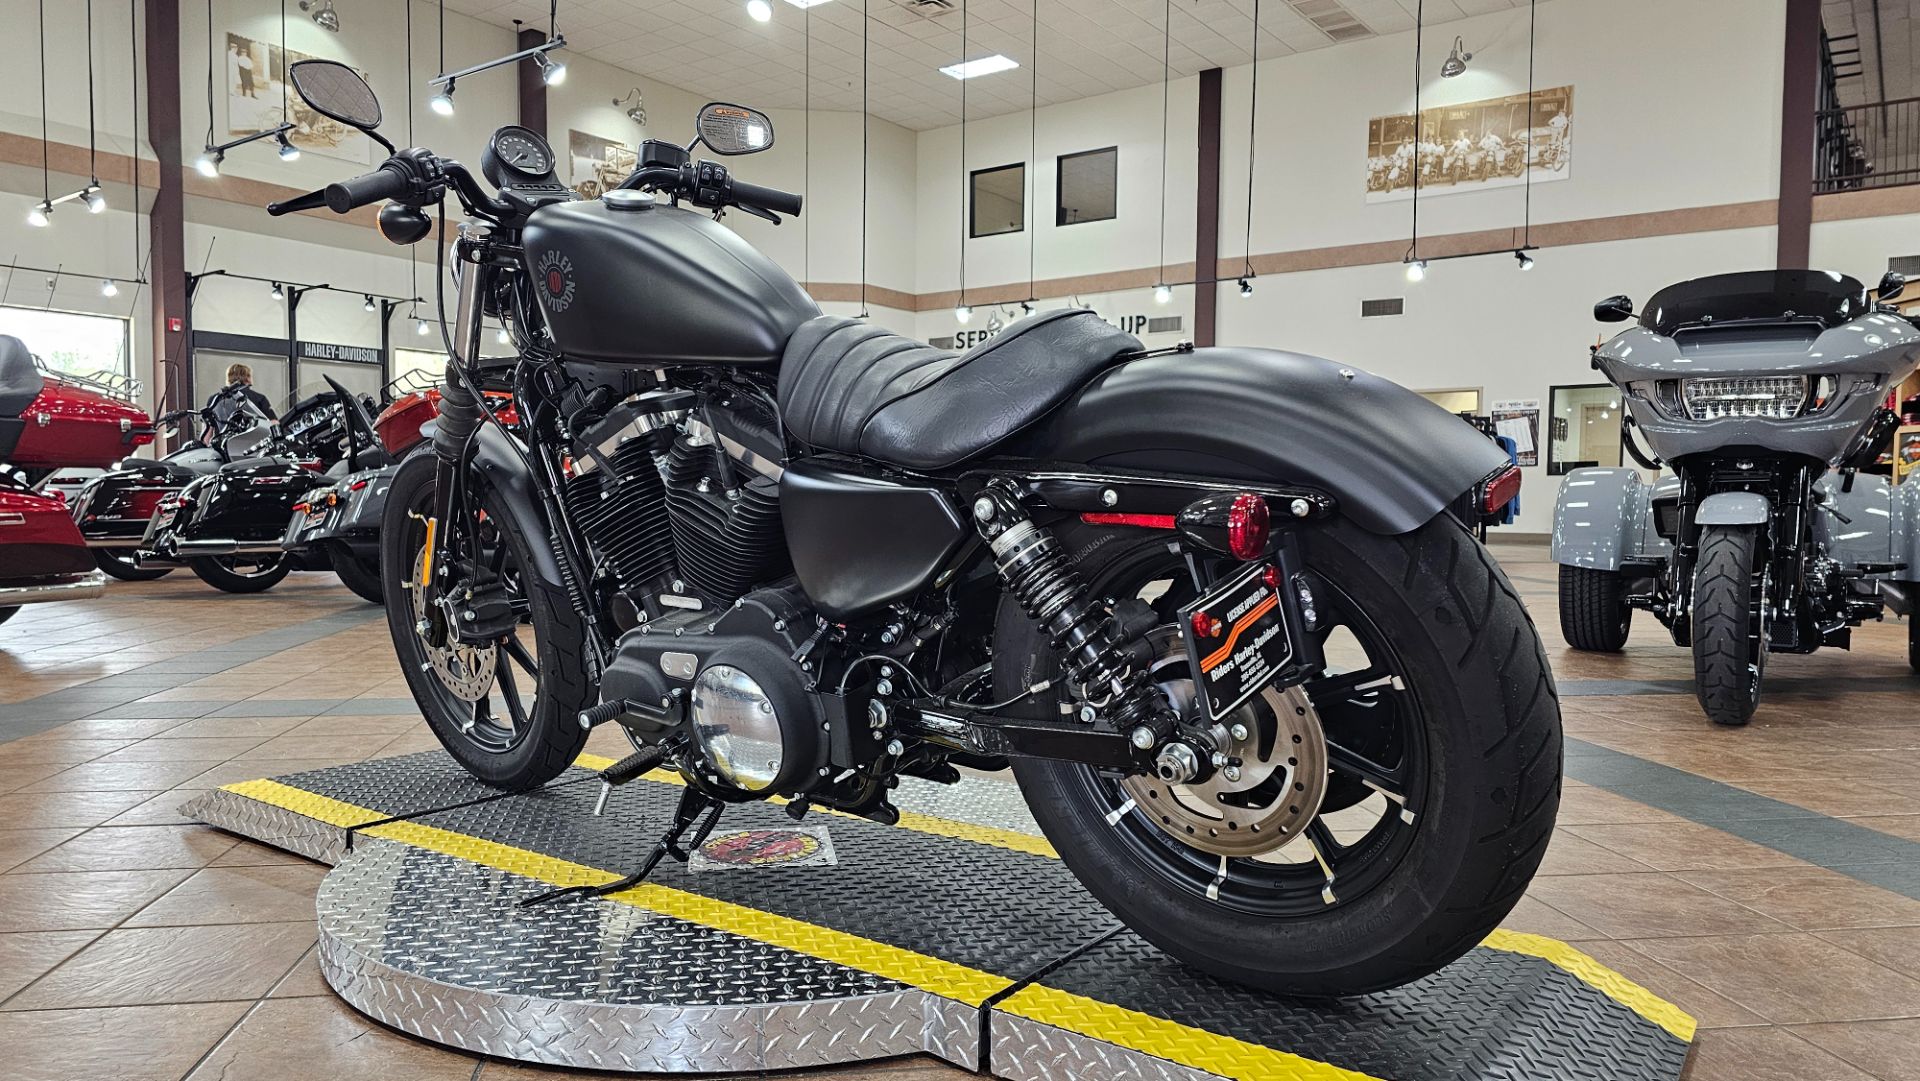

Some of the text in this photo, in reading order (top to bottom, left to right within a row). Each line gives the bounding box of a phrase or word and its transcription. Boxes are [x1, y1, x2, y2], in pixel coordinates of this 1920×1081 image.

[538, 250, 573, 275] HARLEY
[539, 280, 576, 313] DAVIDSON
[304, 342, 378, 363] HARLEY-DAVIDSON
[1226, 602, 1246, 623] LICENSE
[1243, 590, 1261, 611] APPLIED
[1210, 623, 1280, 682] Riders Harley-Davidson
